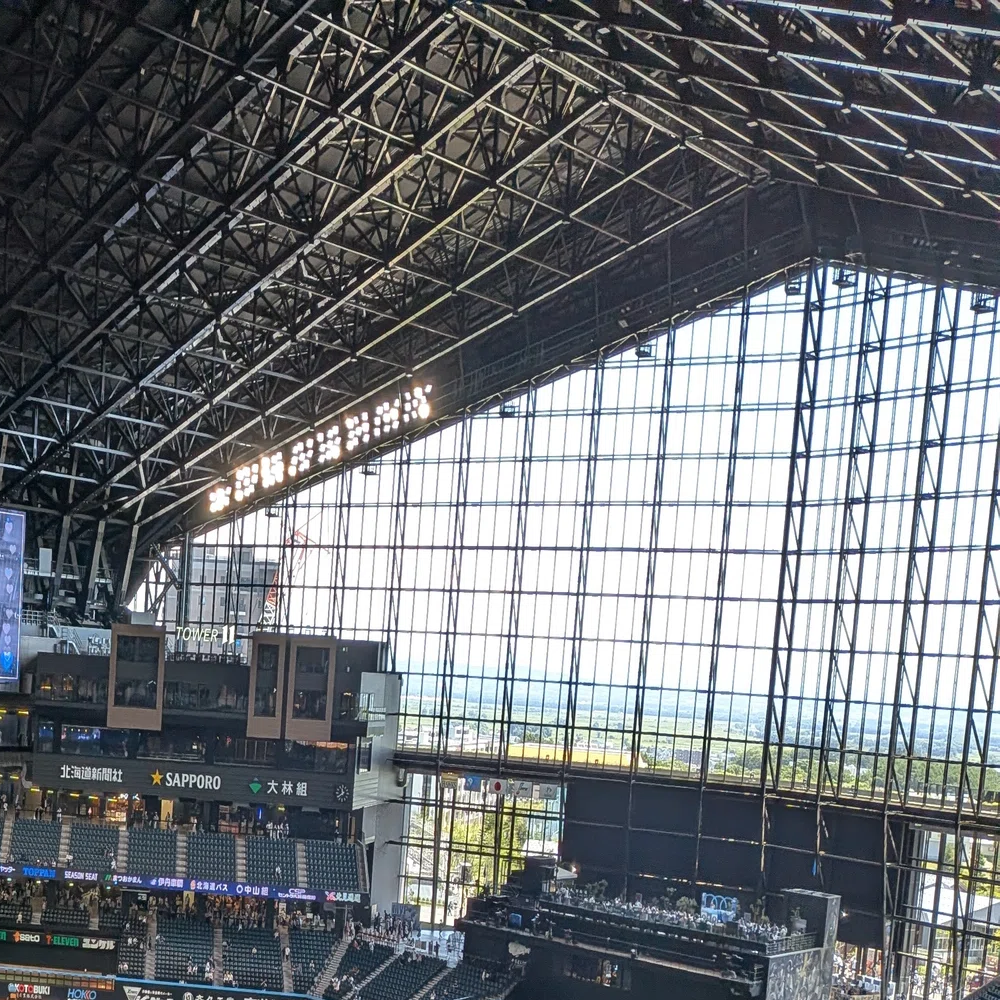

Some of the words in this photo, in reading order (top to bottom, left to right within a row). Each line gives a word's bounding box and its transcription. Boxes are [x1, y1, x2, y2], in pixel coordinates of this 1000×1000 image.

[176, 626, 218, 643] TOWER
[222, 625, 235, 645] 11
[60, 765, 123, 783] 北海道新聞社
[165, 772, 221, 790] SAPPORO
[267, 780, 308, 797] 大林組
[23, 866, 56, 878] TOPPAN
[64, 871, 84, 880] SEASON
[85, 872, 98, 881] SEAT
[15, 983, 50, 995] KOTOBUKI
[67, 988, 97, 1000] HOKKO
